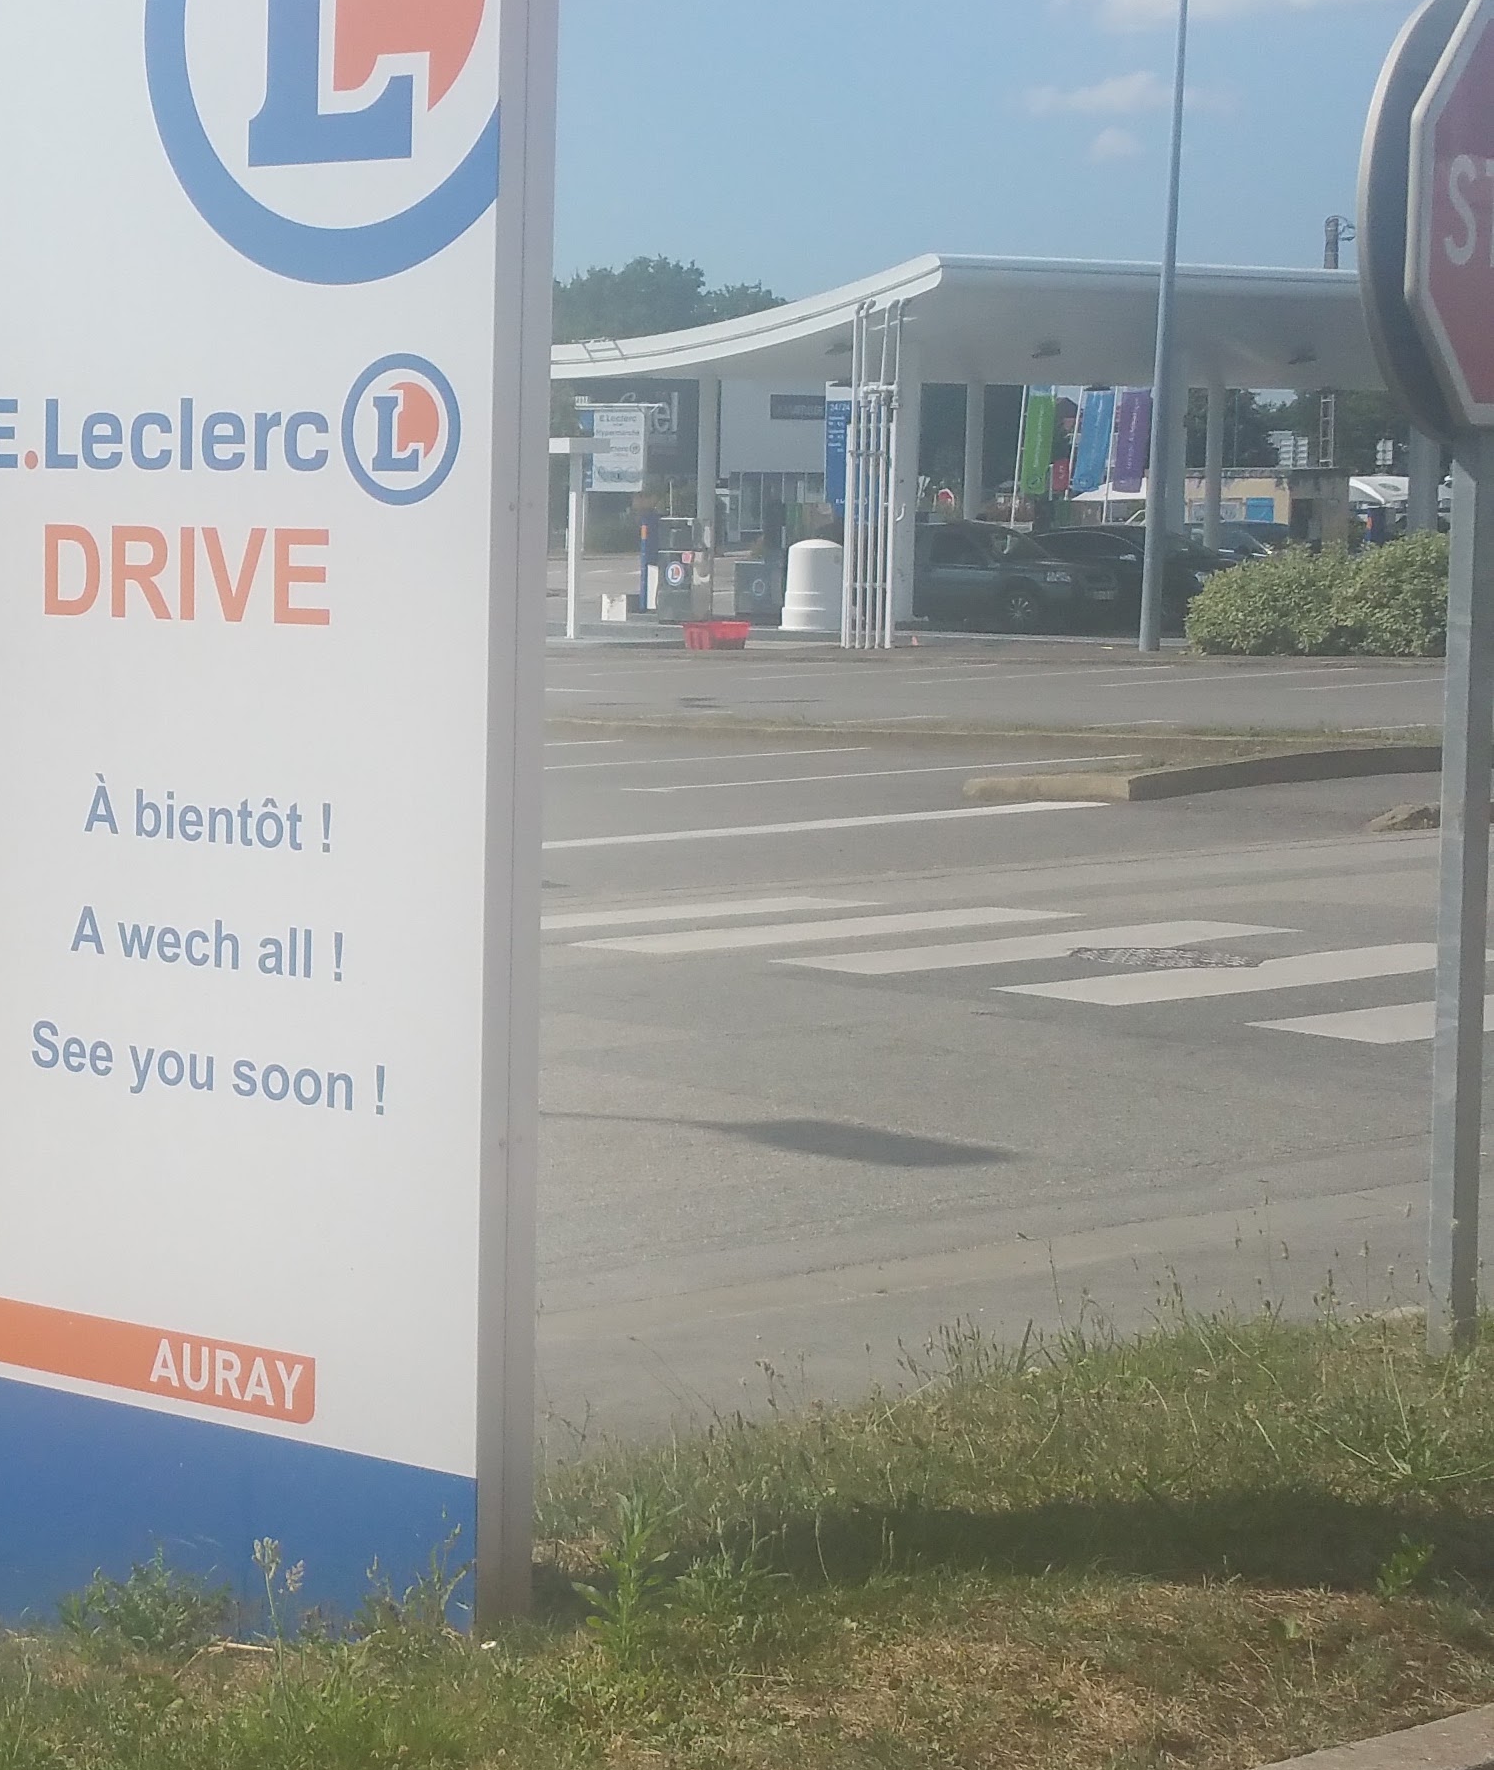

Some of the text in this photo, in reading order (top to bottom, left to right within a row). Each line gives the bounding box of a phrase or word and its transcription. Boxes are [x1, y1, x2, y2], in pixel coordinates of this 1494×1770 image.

[43, 524, 330, 625] DRIVE
[84, 773, 332, 853] À bientôt !
[70, 905, 344, 982] A wech all !
[31, 1020, 386, 1116] See you soon !
[149, 1338, 305, 1411] AURAY
